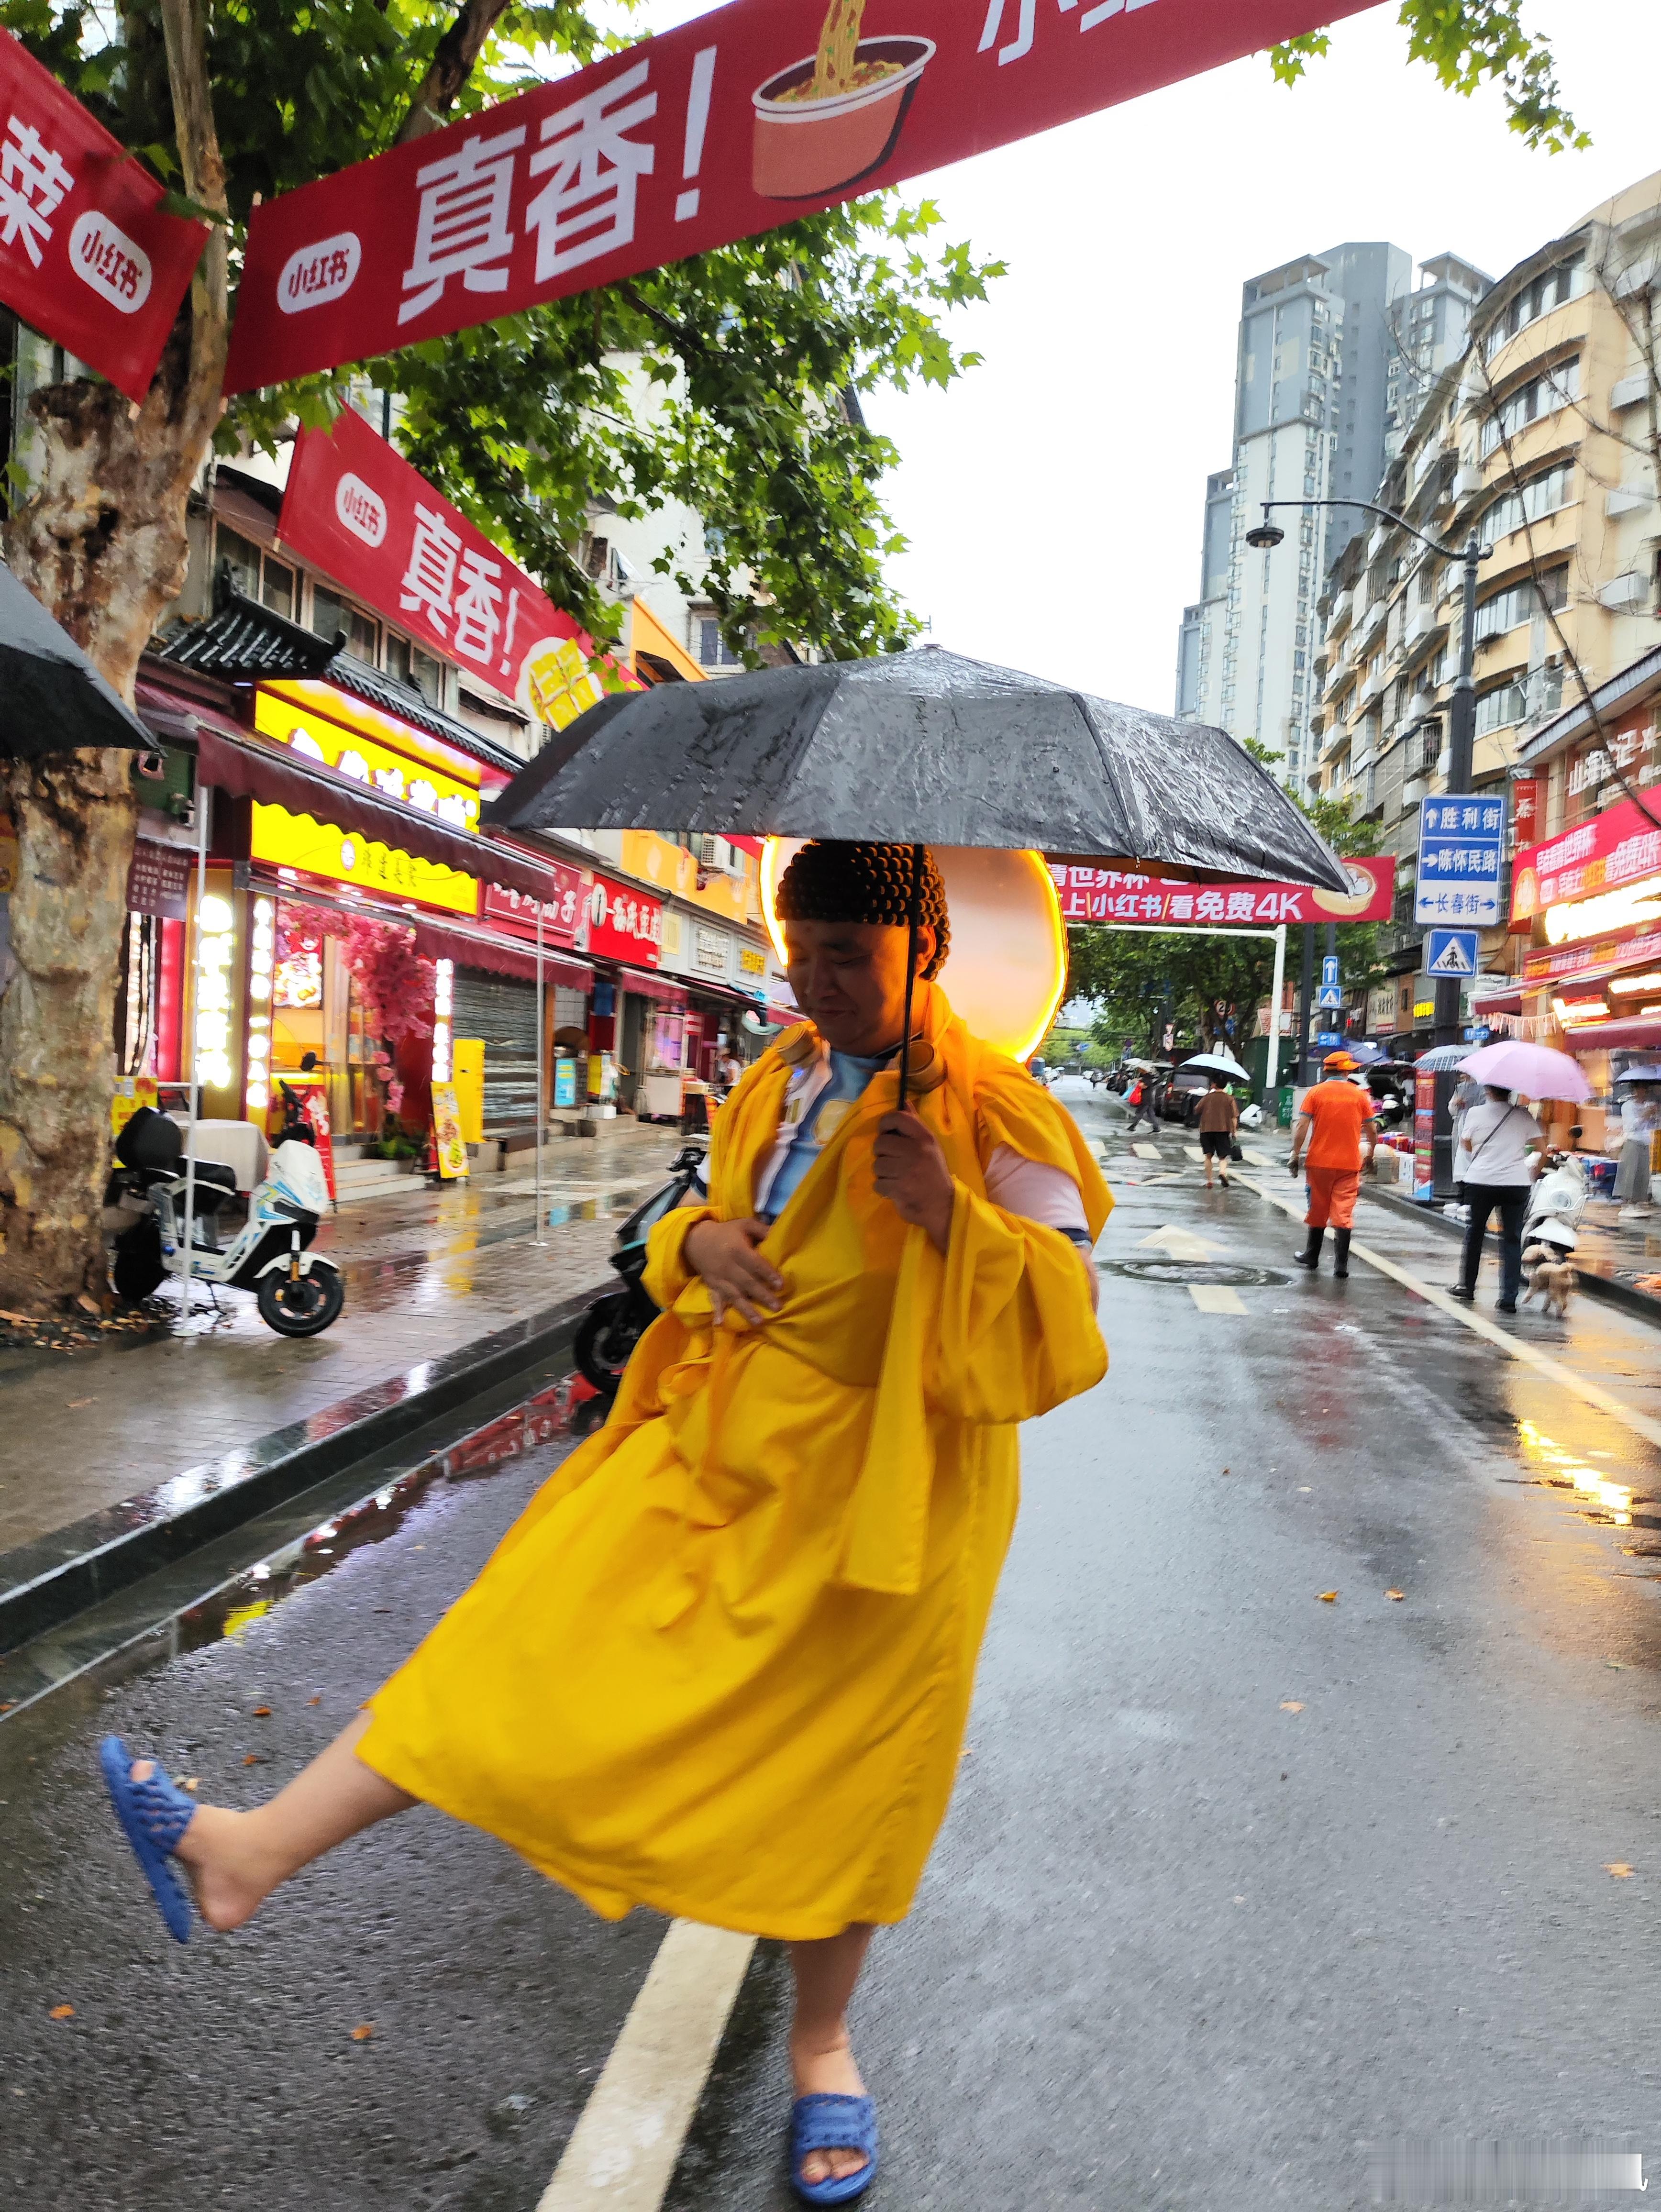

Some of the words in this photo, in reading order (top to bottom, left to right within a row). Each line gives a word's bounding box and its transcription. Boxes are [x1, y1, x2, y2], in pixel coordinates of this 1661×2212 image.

[398, 44, 717, 326] 真香！
[81, 229, 144, 300] 小红书
[288, 248, 351, 299] 小红书
[343, 485, 381, 536] 小红书
[399, 501, 519, 676] 真香！
[1440, 806, 1501, 831] 胜利街
[1438, 848, 1498, 874] 陈怀民路
[1060, 891, 1303, 922] 上小红书看免费4K
[1435, 893, 1480, 915] 长春街
